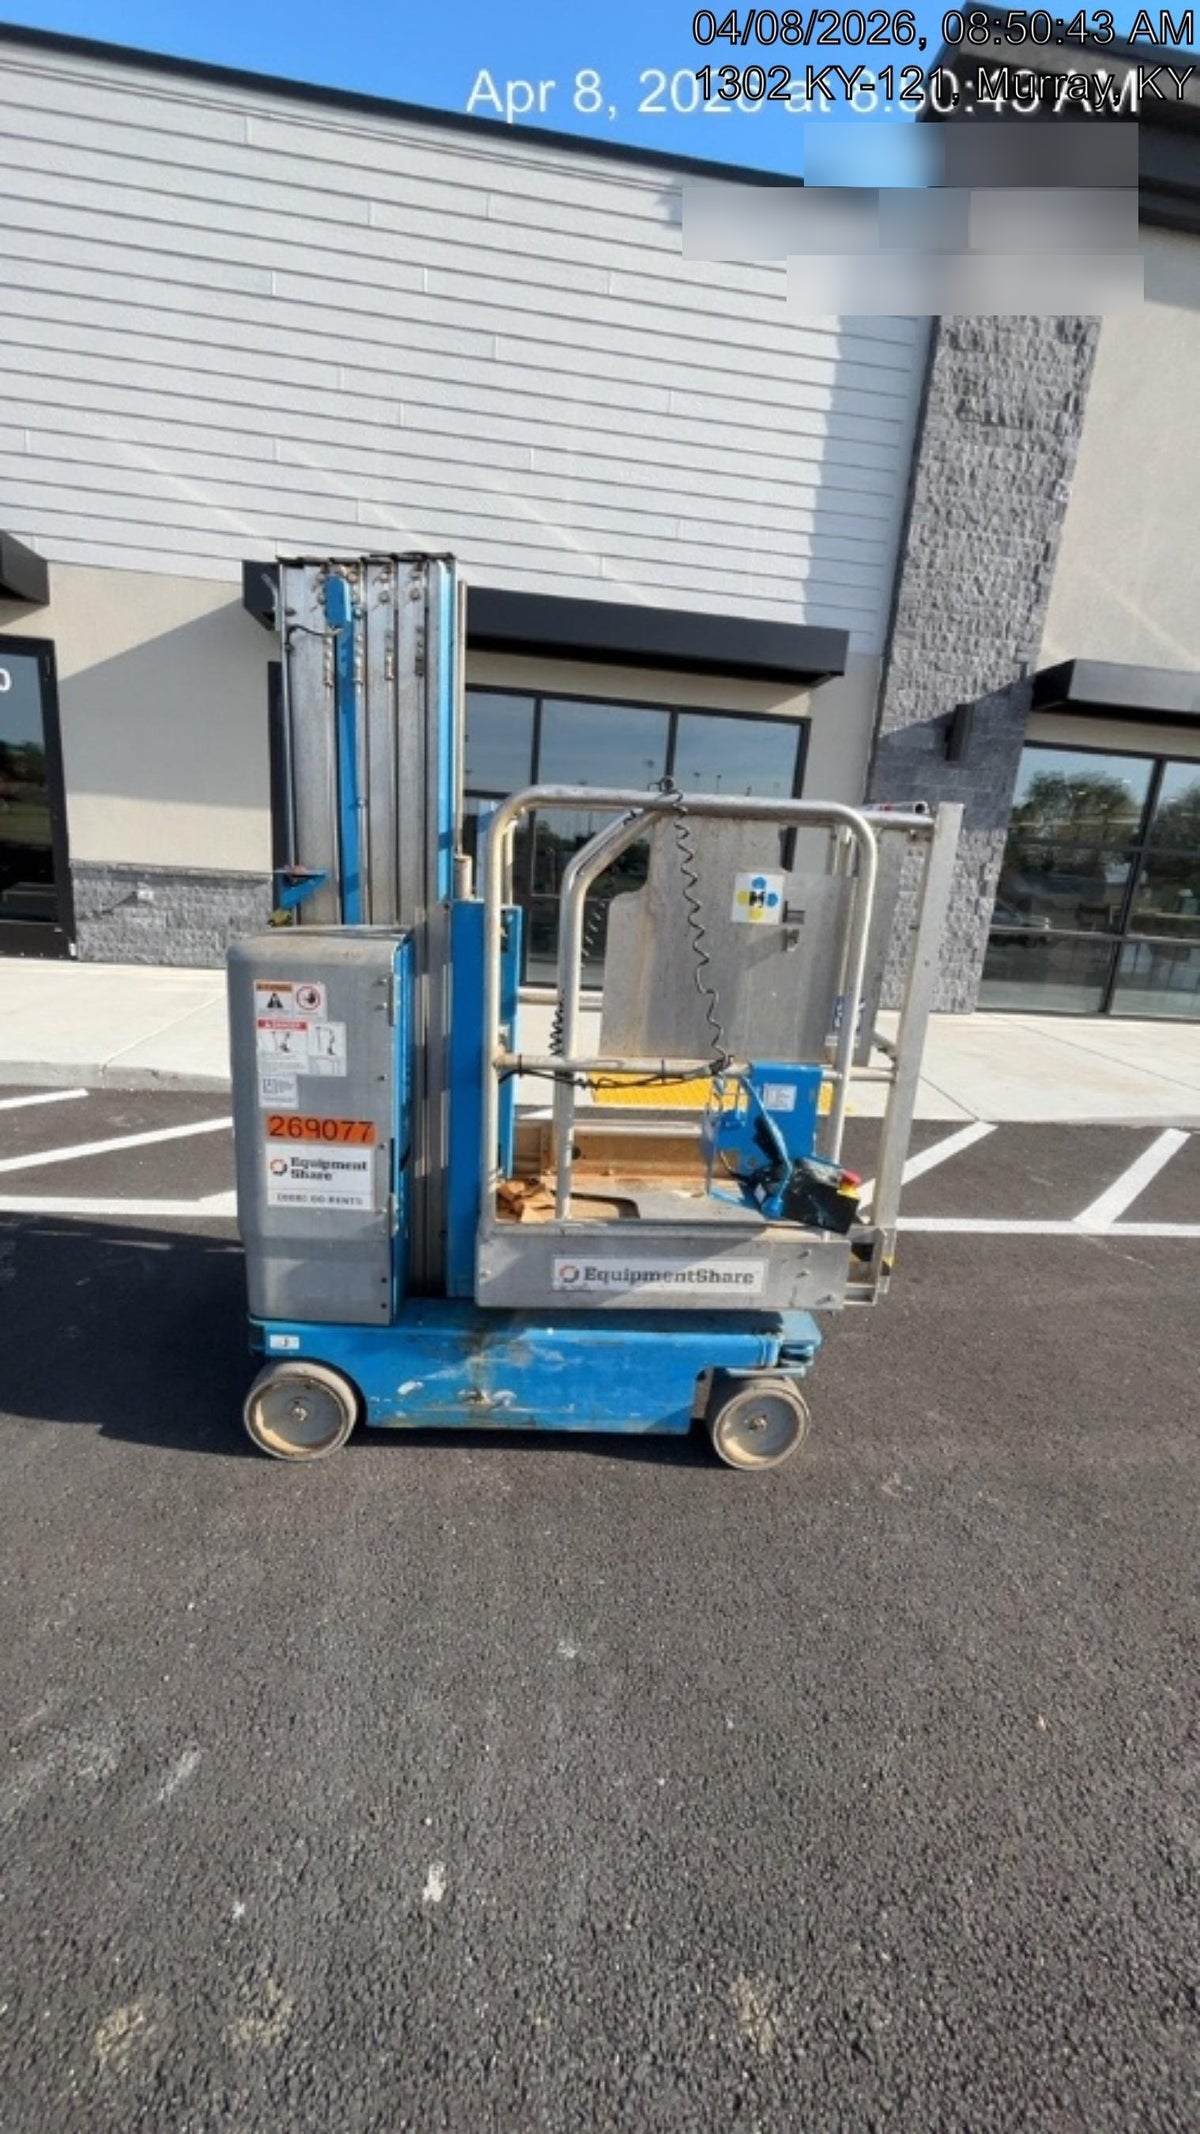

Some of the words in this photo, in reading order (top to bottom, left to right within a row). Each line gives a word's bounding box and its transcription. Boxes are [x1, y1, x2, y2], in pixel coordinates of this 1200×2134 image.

[269, 1115, 373, 1141] 269077
[291, 1157, 367, 1171] Equipment
[291, 1168, 333, 1181] Share
[583, 1266, 754, 1284] EquipmentShare
